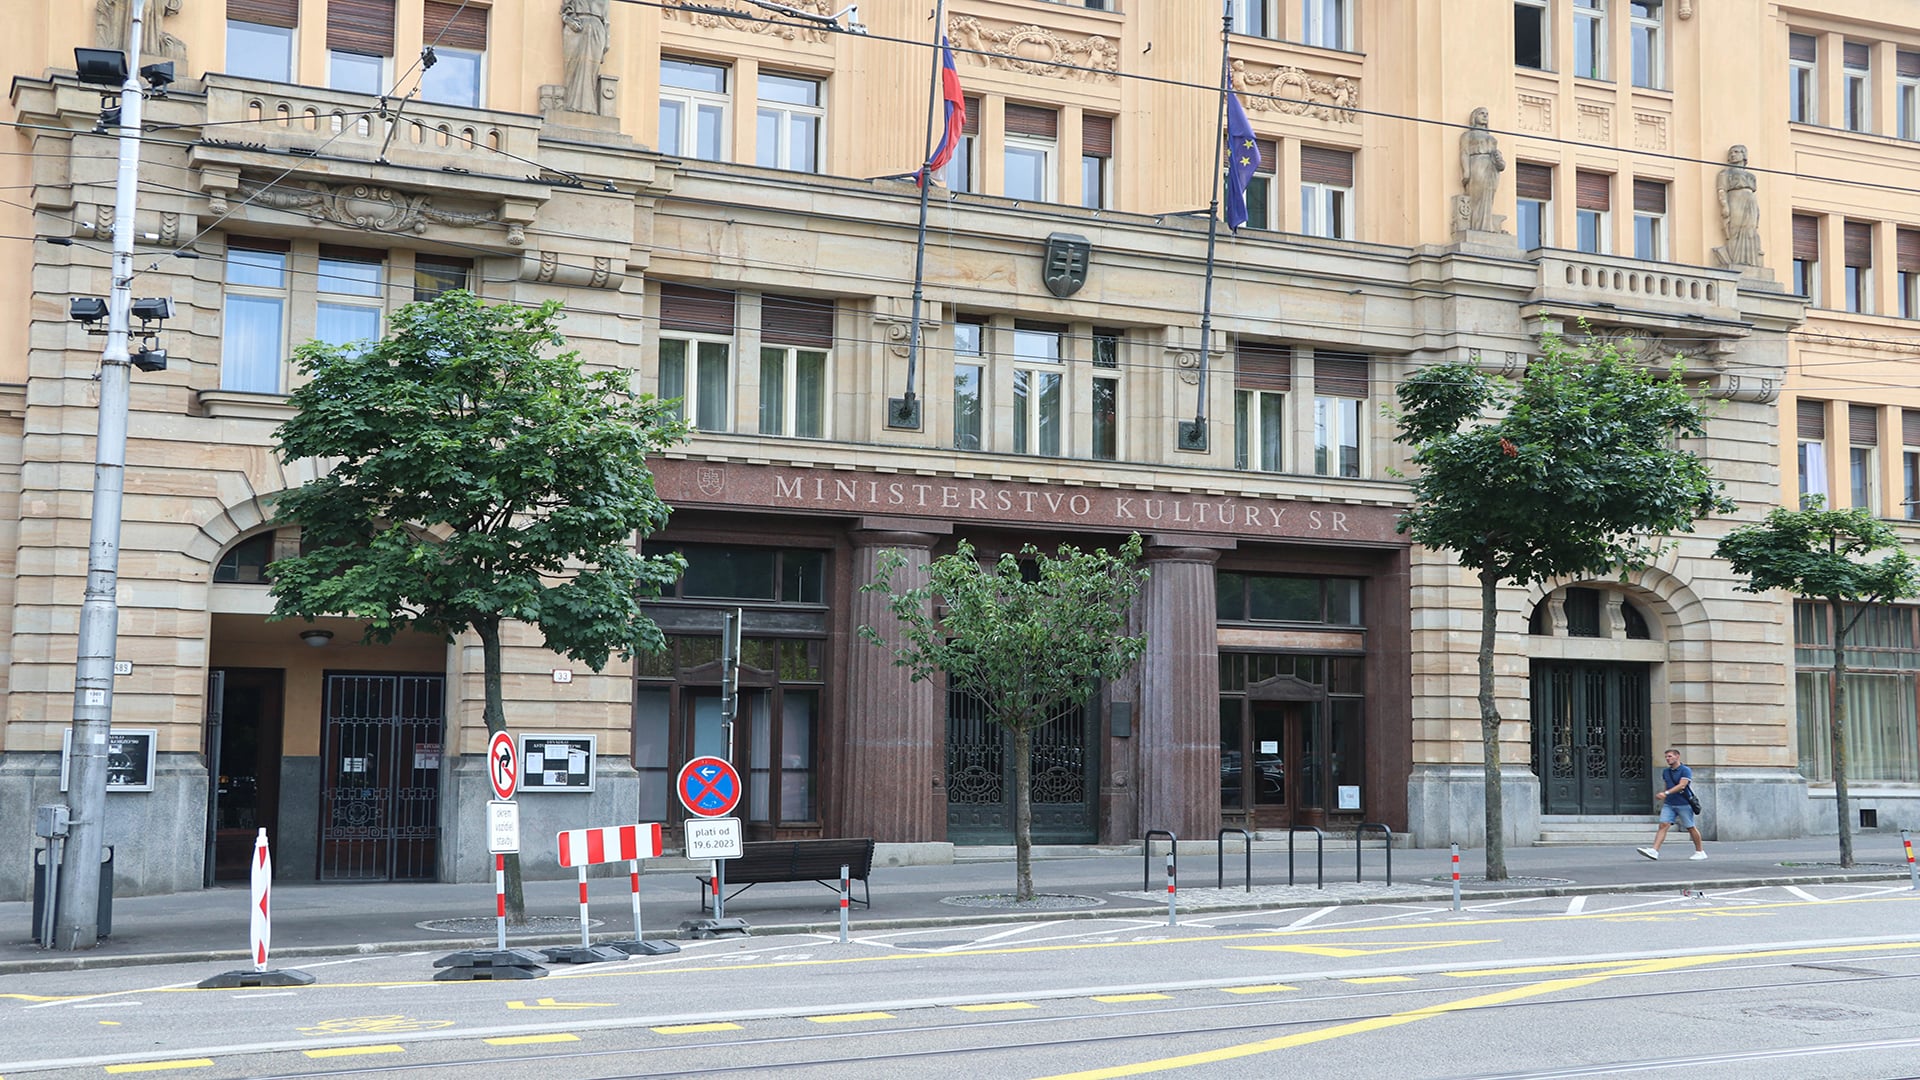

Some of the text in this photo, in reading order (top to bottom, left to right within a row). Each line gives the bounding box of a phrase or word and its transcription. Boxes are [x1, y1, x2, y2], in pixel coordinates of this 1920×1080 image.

[775, 475, 1349, 532] MINISTERSTVO KULTÚRY SR
[558, 672, 568, 680] 33
[719, 828, 730, 836] od
[694, 839, 734, 849] 19.6.2023
